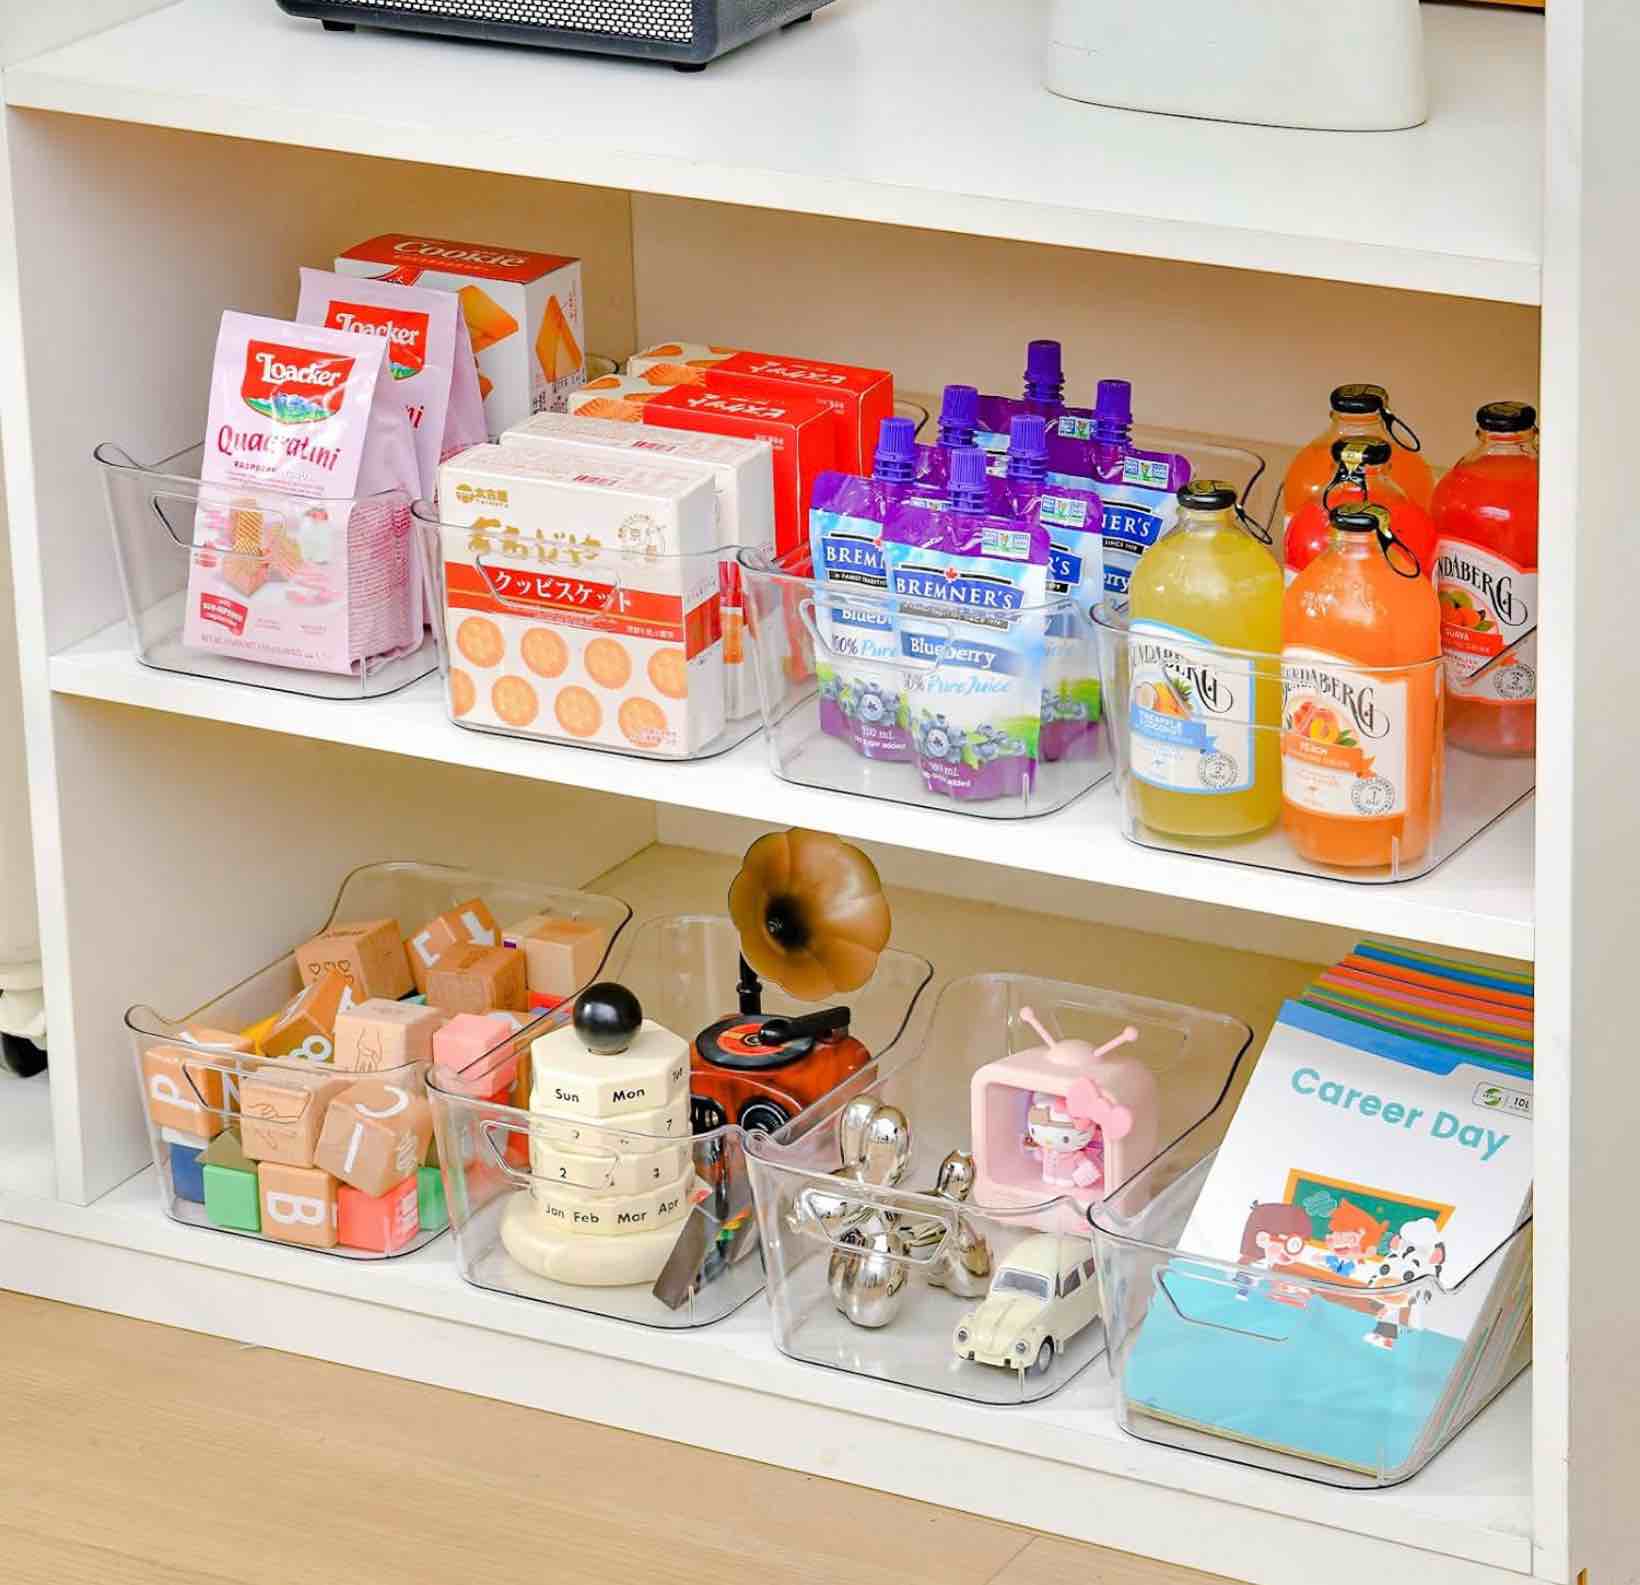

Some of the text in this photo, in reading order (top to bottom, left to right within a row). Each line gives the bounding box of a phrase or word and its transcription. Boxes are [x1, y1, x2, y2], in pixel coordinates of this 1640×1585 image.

[393, 241, 526, 267] Cookie
[256, 351, 341, 386] Loacker
[896, 577, 1015, 610] BREMNER'S
[911, 634, 996, 669] Blueberry
[555, 1087, 580, 1103] Sun
[612, 1086, 646, 1103] Mon
[1291, 1067, 1511, 1162] Career Day
[559, 1167, 567, 1179] 2
[267, 1191, 326, 1225] B
[573, 1211, 600, 1224] Feb
[617, 1211, 648, 1224] Mar
[658, 1199, 680, 1216] Apr
